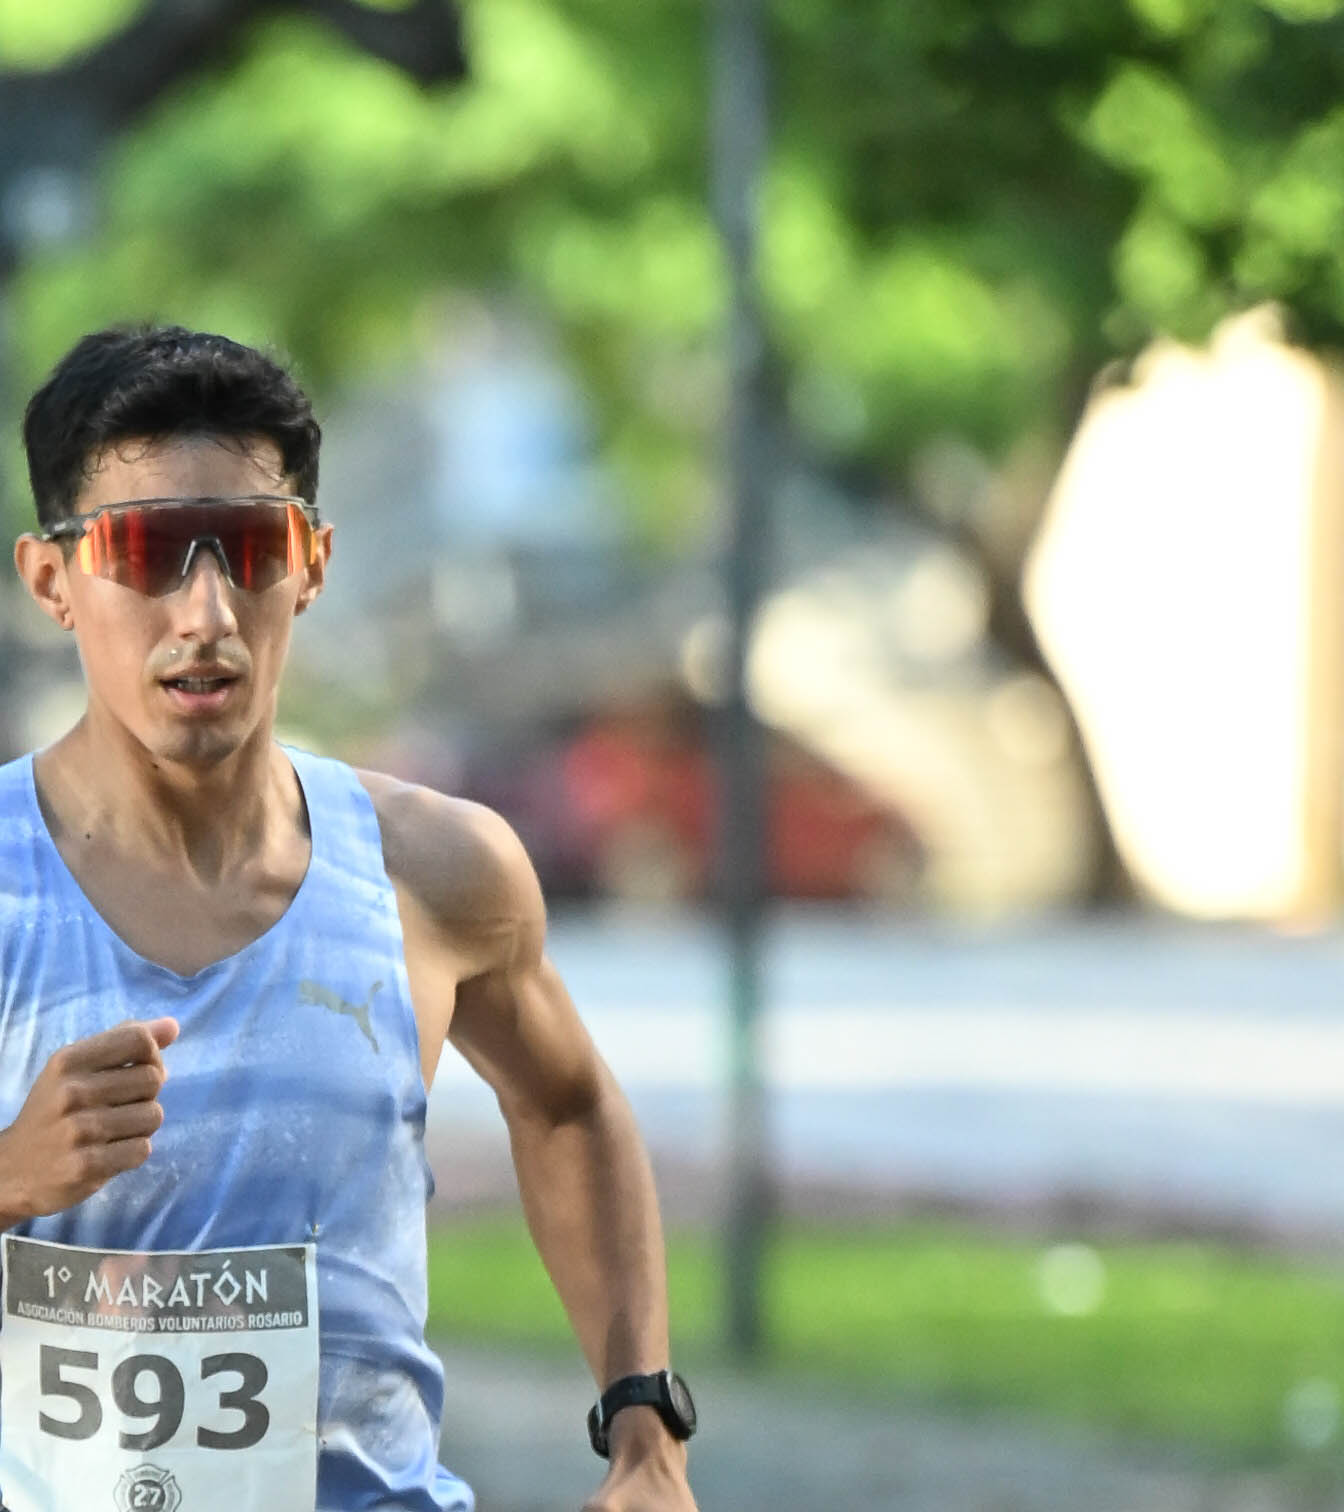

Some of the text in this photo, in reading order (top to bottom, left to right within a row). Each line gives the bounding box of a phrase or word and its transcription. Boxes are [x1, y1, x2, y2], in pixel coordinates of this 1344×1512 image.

[84, 1259, 268, 1308] MARATÓN
[87, 1312, 155, 1331] BOMBEROS
[158, 1315, 245, 1332] VOLUNTARIOS
[248, 1310, 303, 1329] ROSARIO
[39, 1344, 270, 1452] 593
[134, 1484, 161, 1507] 27
